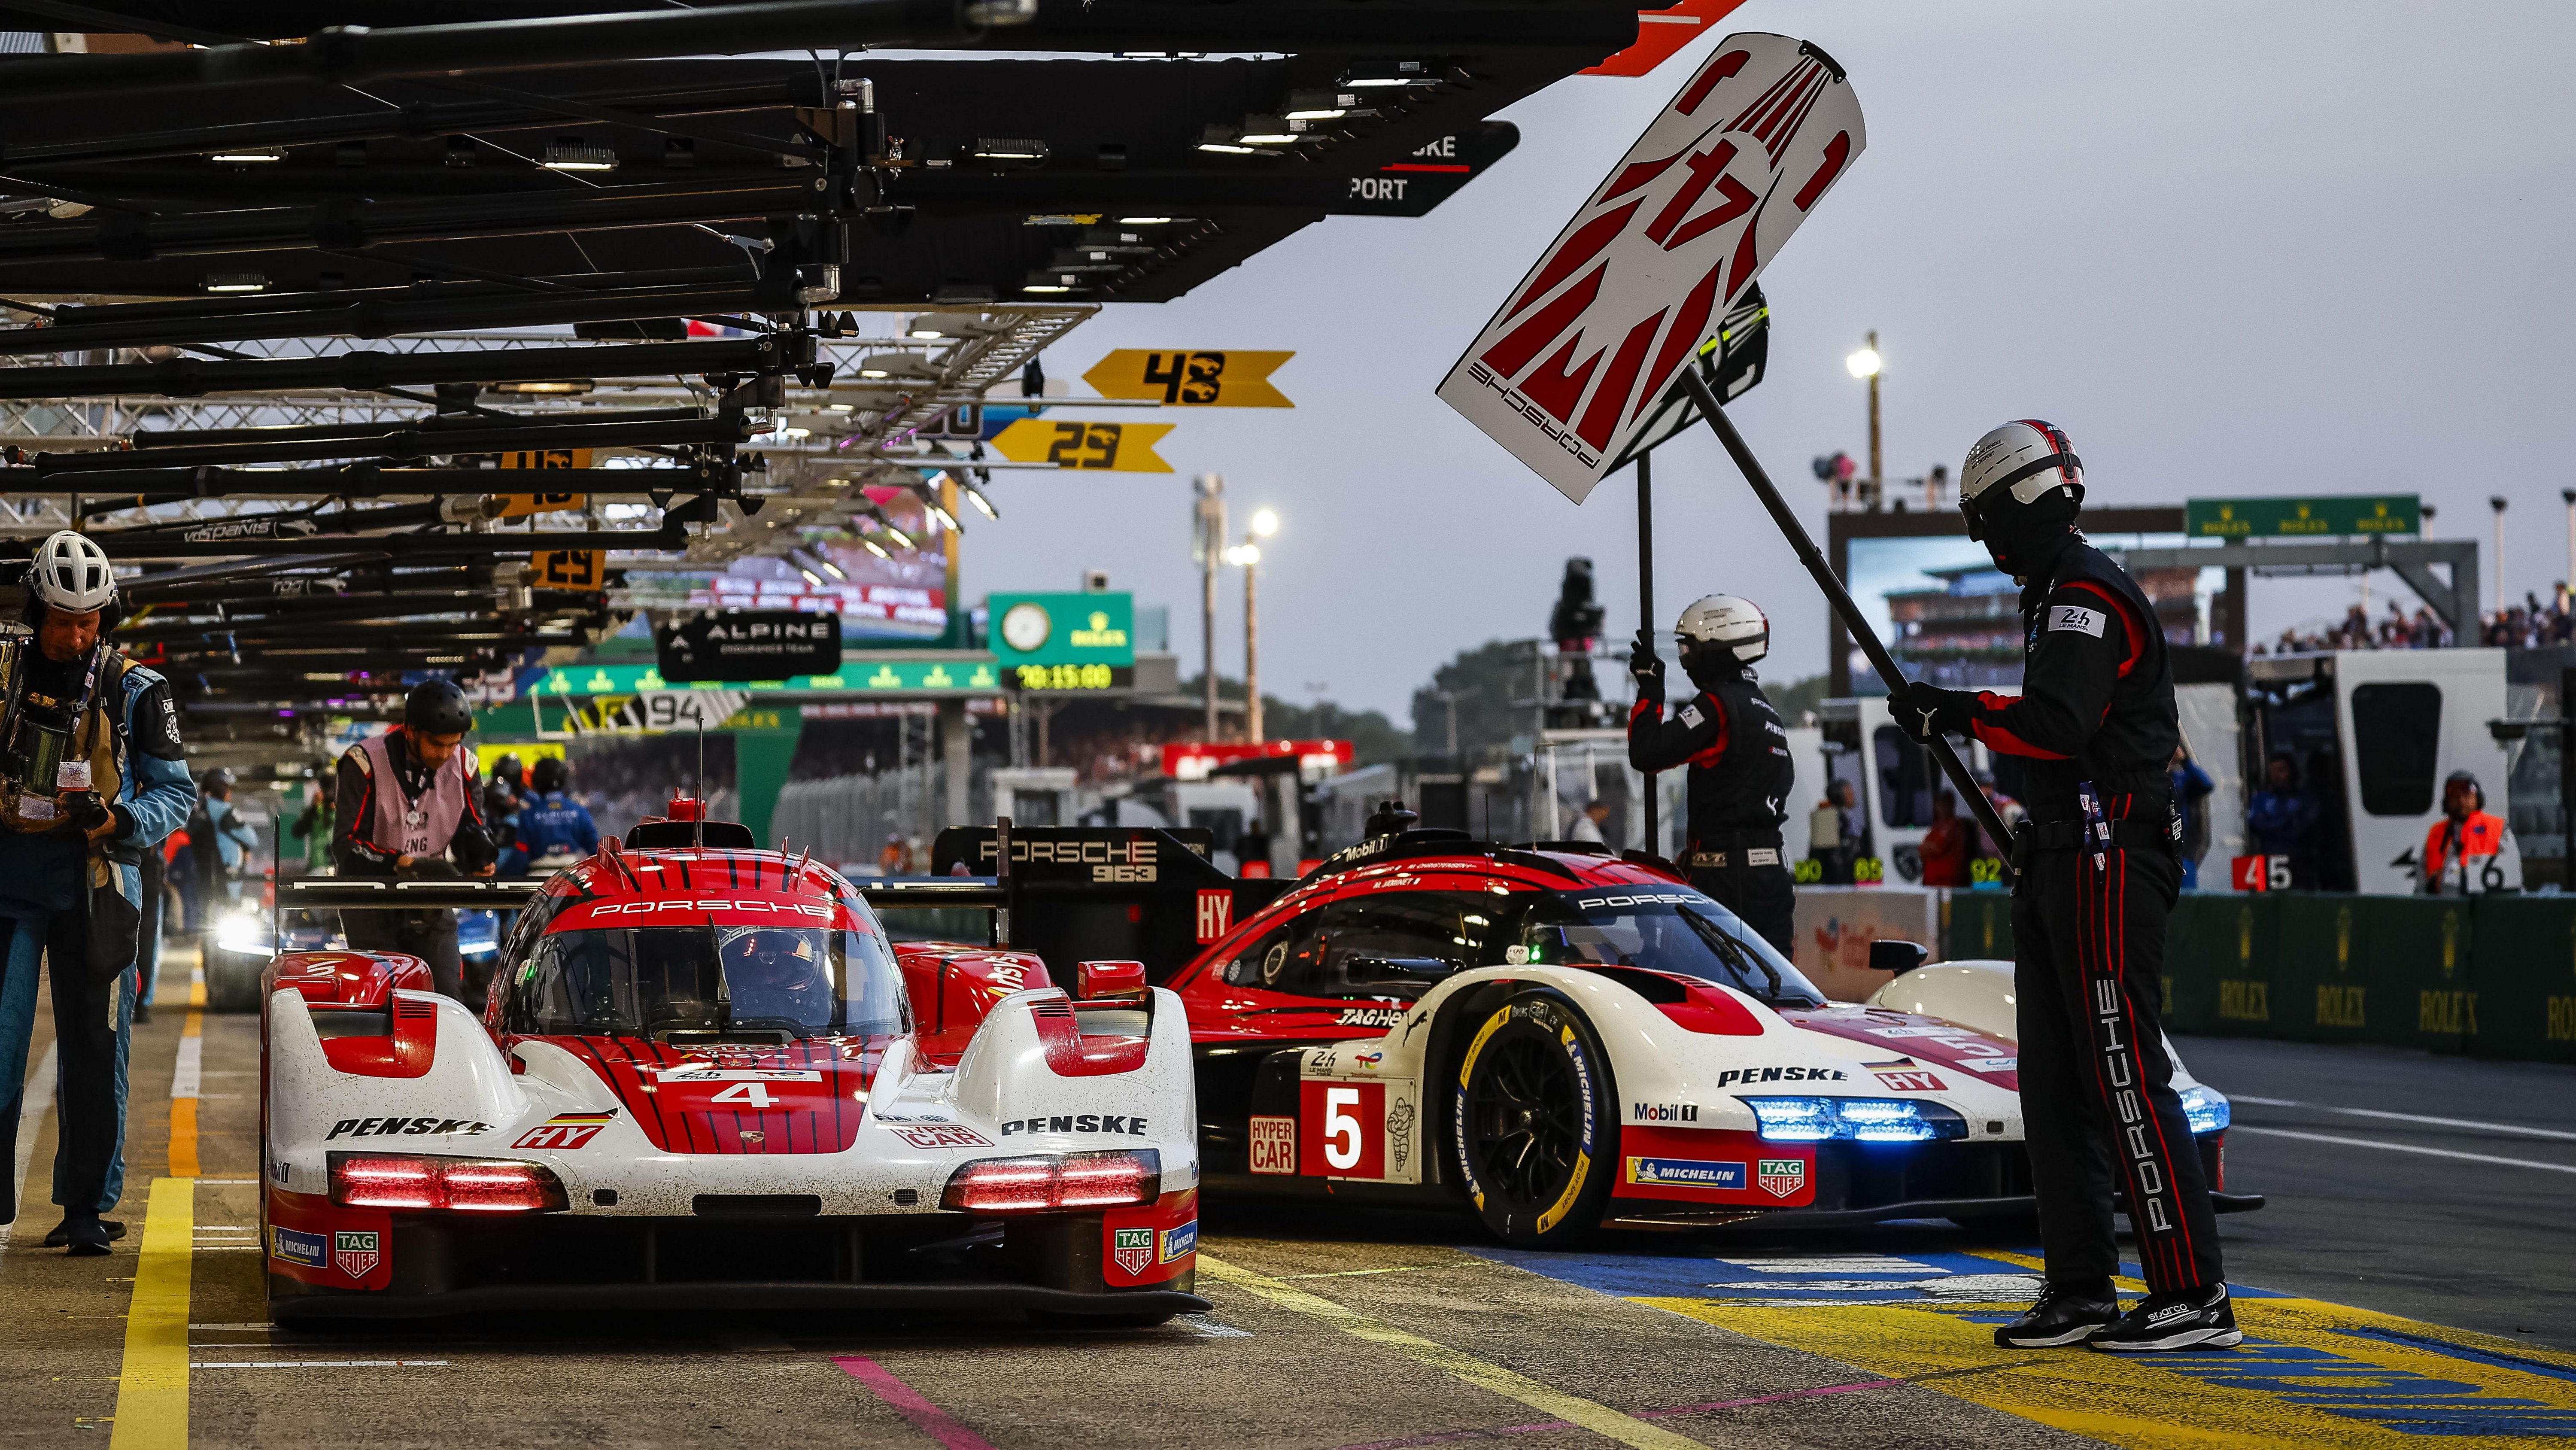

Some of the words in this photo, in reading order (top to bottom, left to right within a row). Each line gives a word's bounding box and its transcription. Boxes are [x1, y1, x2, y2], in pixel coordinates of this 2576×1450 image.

[1144, 352, 1226, 404] 48
[1467, 361, 1601, 469] PORSCHE
[1048, 422, 1122, 468] 29
[2060, 608, 2090, 626] 24h
[2067, 623, 2087, 631] MANS
[706, 623, 830, 640] ALPINE
[652, 693, 701, 724] 94
[980, 840, 1157, 863] PORSCHE
[1346, 839, 1376, 862] Mobil
[1093, 865, 1157, 883] 963
[1970, 857, 2002, 882] 92
[590, 900, 835, 921] PORSCHE
[1198, 894, 1230, 939] HY
[2219, 979, 2269, 1021] ROLEX
[1498, 1009, 1507, 1025] M
[2419, 989, 2479, 1034] ROLEX
[1310, 1051, 1337, 1067] 24h
[1717, 1067, 1848, 1088] PENSKE
[1877, 1073, 1936, 1090] HY
[710, 1082, 780, 1108] 4
[1573, 1055, 1592, 1146] MICHELIN
[1634, 1102, 1678, 1121] Mobil
[2096, 979, 2172, 1233] PORSCHE
[324, 1118, 496, 1141] PENSKE
[1001, 1114, 1148, 1136] PENSKE
[1252, 1121, 1292, 1141] HYPER
[1324, 1087, 1362, 1170] 5
[519, 1127, 597, 1147] HY
[907, 1133, 987, 1146] CAR
[1456, 1093, 1473, 1182] MICHELIN
[1252, 1139, 1292, 1170] CAR
[1660, 1167, 1735, 1181] MICHELIN
[1763, 1162, 1800, 1174] TAG
[1761, 1176, 1800, 1196] HEUER
[1562, 1185, 1576, 1210] SPORT
[285, 1240, 320, 1257] MICHELIN
[338, 1235, 374, 1249] TAG
[1119, 1231, 1150, 1246] TAG
[1173, 1231, 1194, 1251] MICHELIN
[338, 1252, 376, 1275] HEUER
[1118, 1249, 1151, 1271] HEUER
[2148, 1304, 2187, 1321] sparco
